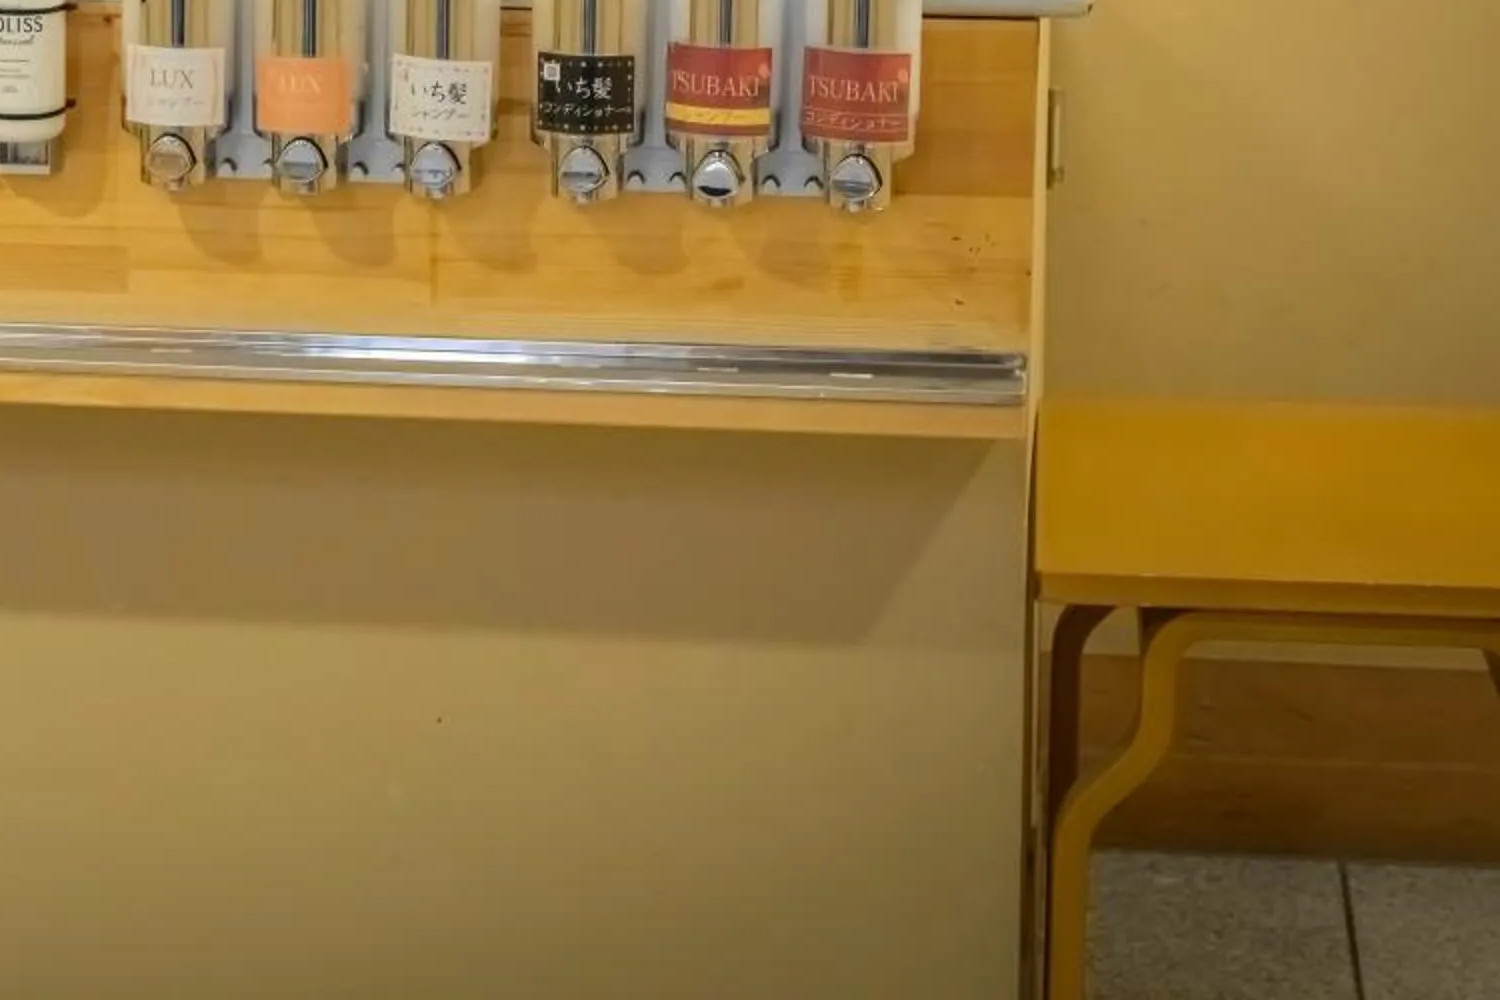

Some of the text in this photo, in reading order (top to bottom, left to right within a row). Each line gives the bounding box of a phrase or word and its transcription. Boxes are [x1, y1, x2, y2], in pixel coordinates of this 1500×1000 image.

[150, 68, 195, 89] LUX
[672, 69, 759, 98] TSUBAKI
[809, 75, 899, 103] TSUBAKI
